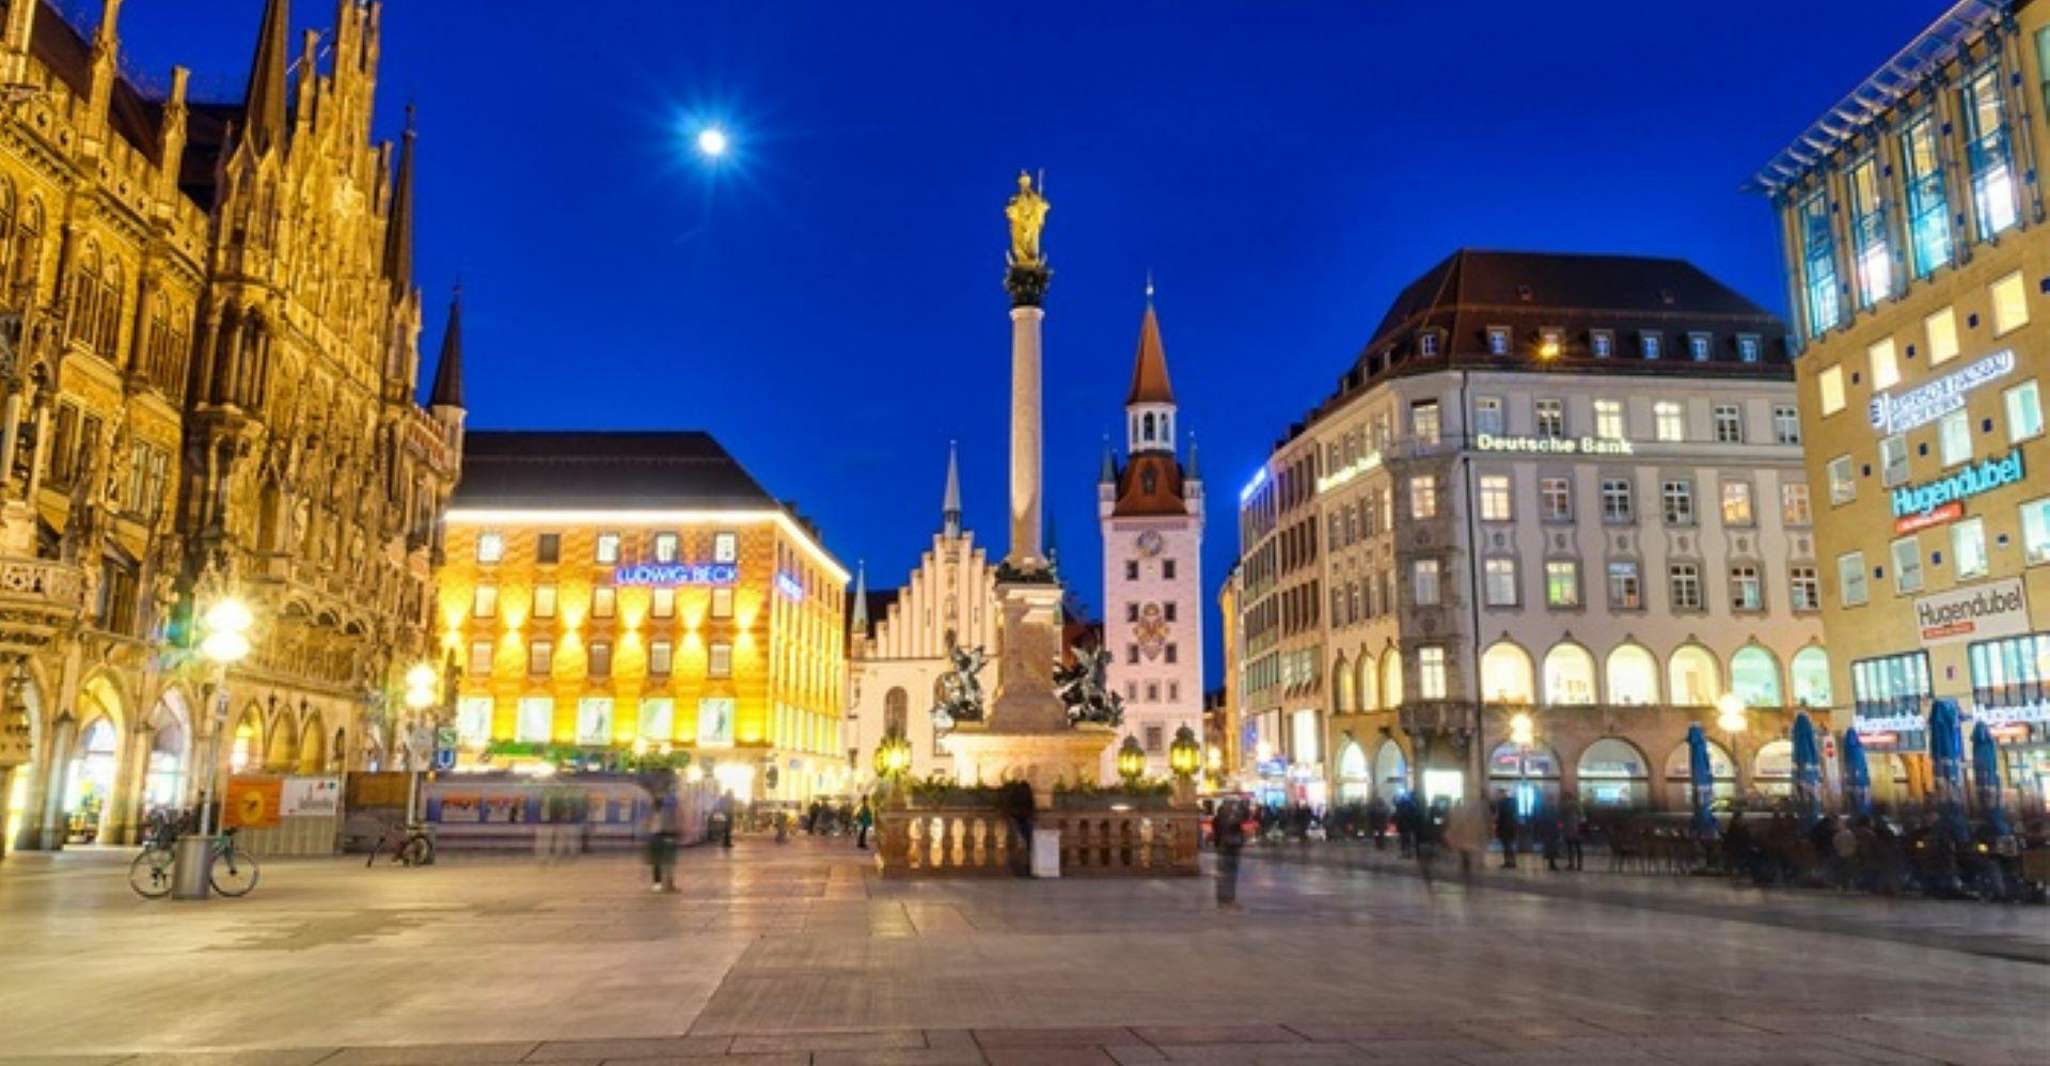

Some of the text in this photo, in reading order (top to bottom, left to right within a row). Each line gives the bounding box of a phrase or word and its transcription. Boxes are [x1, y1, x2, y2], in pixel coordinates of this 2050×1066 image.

[1477, 433, 1633, 455] Deutsche Bank
[1892, 448, 2021, 518] Hugendubel
[617, 563, 738, 584] LUDWIG BECK
[1918, 583, 2023, 626] Hugendubel
